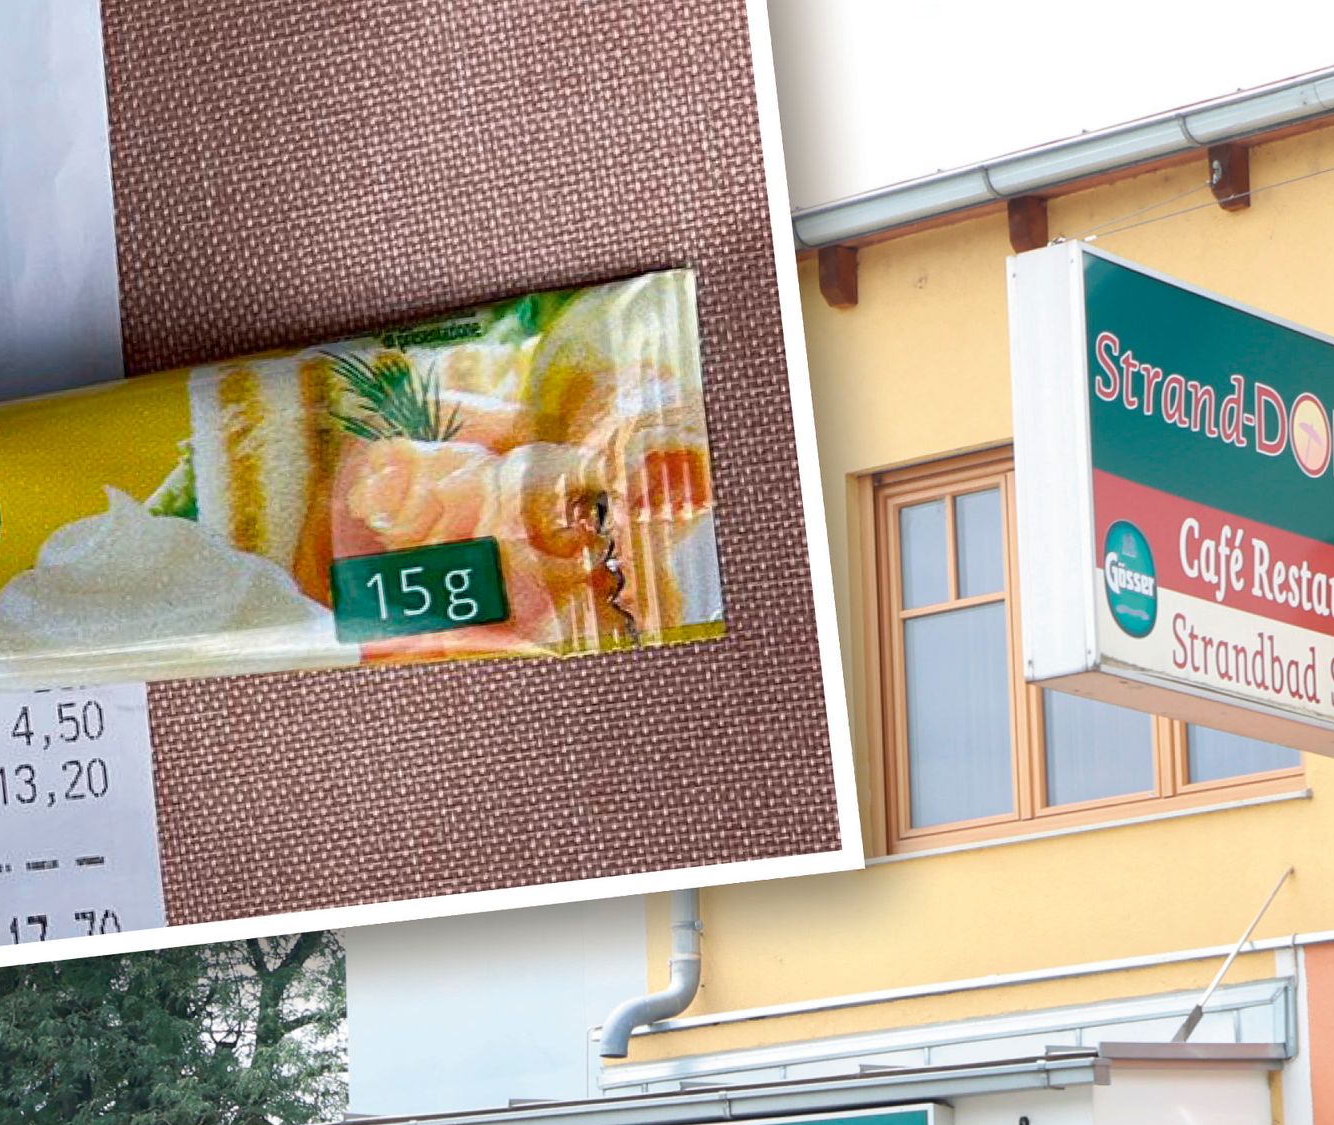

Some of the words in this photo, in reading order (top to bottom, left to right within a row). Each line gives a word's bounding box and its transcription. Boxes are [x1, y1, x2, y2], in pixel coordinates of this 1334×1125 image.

[1105, 551, 1155, 597] Gösser
[1178, 517, 1244, 602] Café
[366, 566, 432, 621] 15
[444, 567, 479, 622] g
[1172, 612, 1320, 705] Strandbad
[11, 700, 105, 751] 4,50
